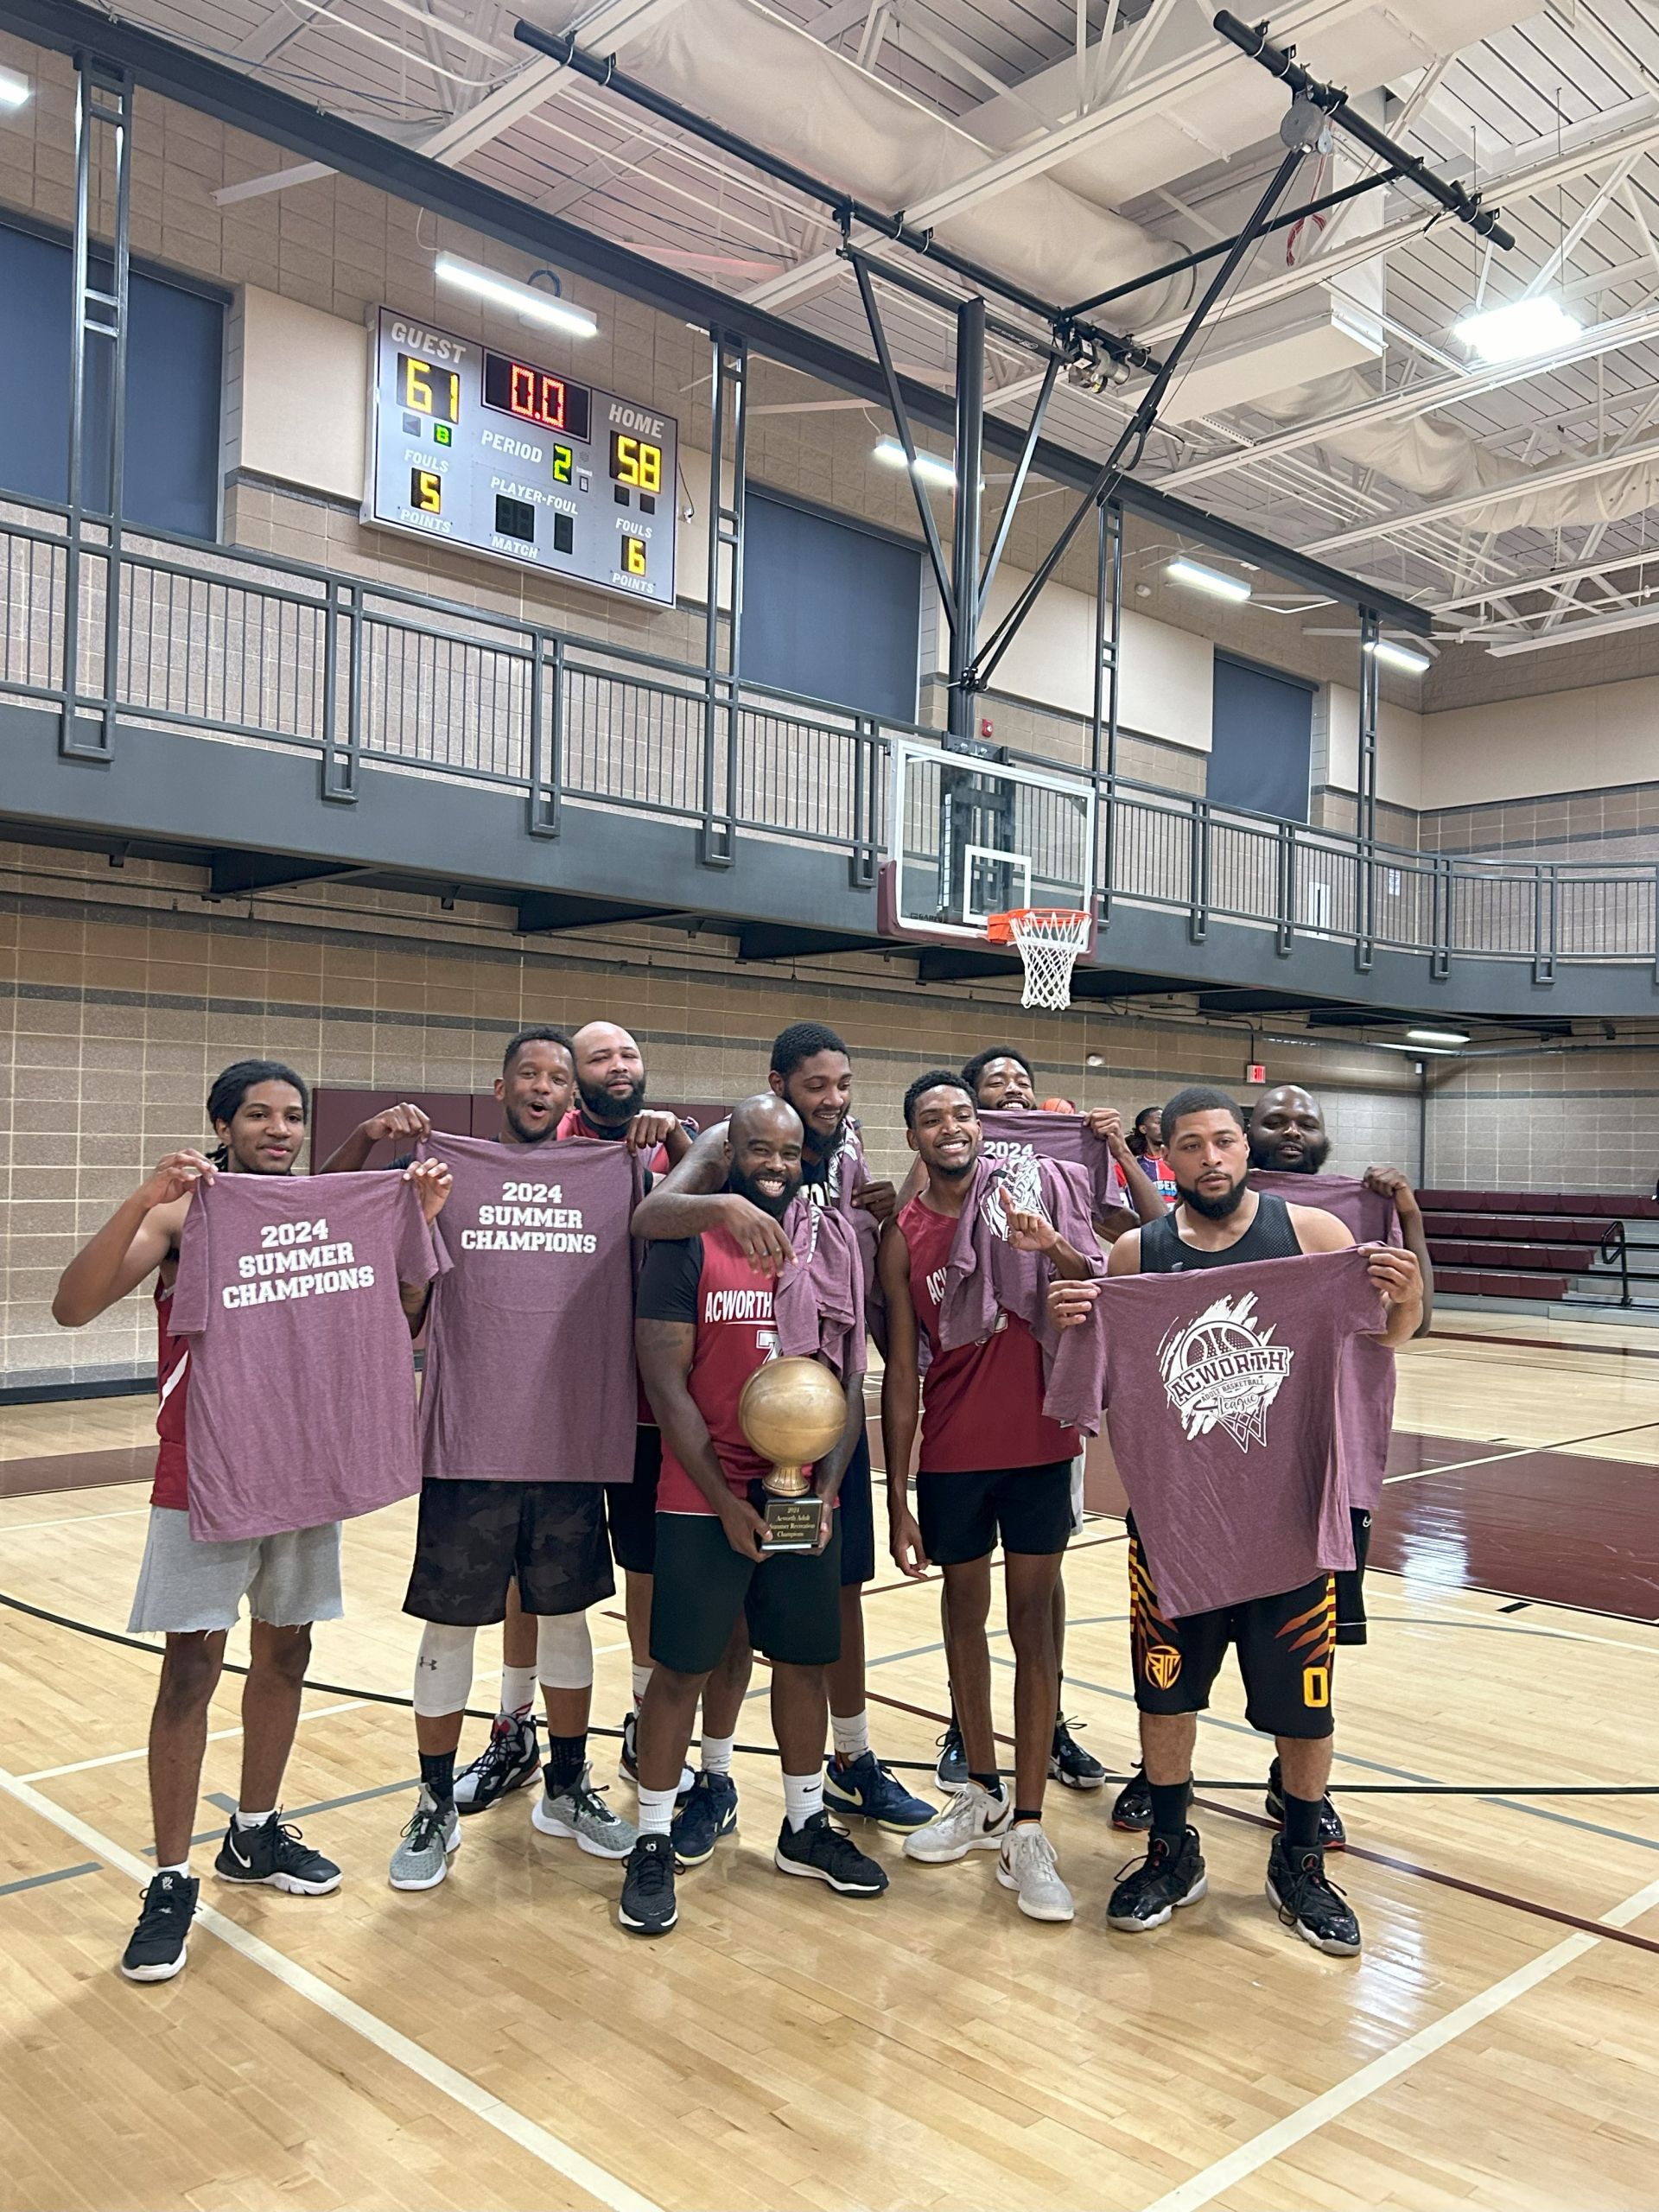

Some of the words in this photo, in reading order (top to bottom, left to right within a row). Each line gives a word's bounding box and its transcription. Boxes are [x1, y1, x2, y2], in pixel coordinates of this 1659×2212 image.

[391, 322, 467, 363] GUEST
[406, 356, 459, 423] 61
[511, 363, 564, 428] 0.0
[608, 404, 664, 439] HOME
[404, 448, 449, 474] FOULS
[480, 429, 543, 463] PERIOD
[554, 444, 571, 482] 2
[618, 435, 661, 493] 58
[420, 471, 440, 513] 5
[490, 476, 578, 515] PLAYER-FOUL
[400, 508, 451, 533] POINTS
[615, 517, 653, 538] FOULS
[491, 536, 538, 559] MATCH
[628, 537, 645, 575] 6
[612, 572, 655, 594] POINTS
[983, 1141, 1034, 1159] 2024
[502, 1181, 563, 1204] 2024
[260, 1218, 329, 1249] 2024
[478, 1205, 583, 1229] SUMMER
[461, 1229, 597, 1254] CHAMPIONS
[238, 1242, 355, 1279] SUMMER
[221, 1265, 375, 1309] CHAMPIONS
[704, 1289, 773, 1323] ACWORTH
[1171, 1351, 1285, 1403] ACWORTH
[1221, 1379, 1264, 1392] BASKETBALL
[1217, 1393, 1258, 1415] League
